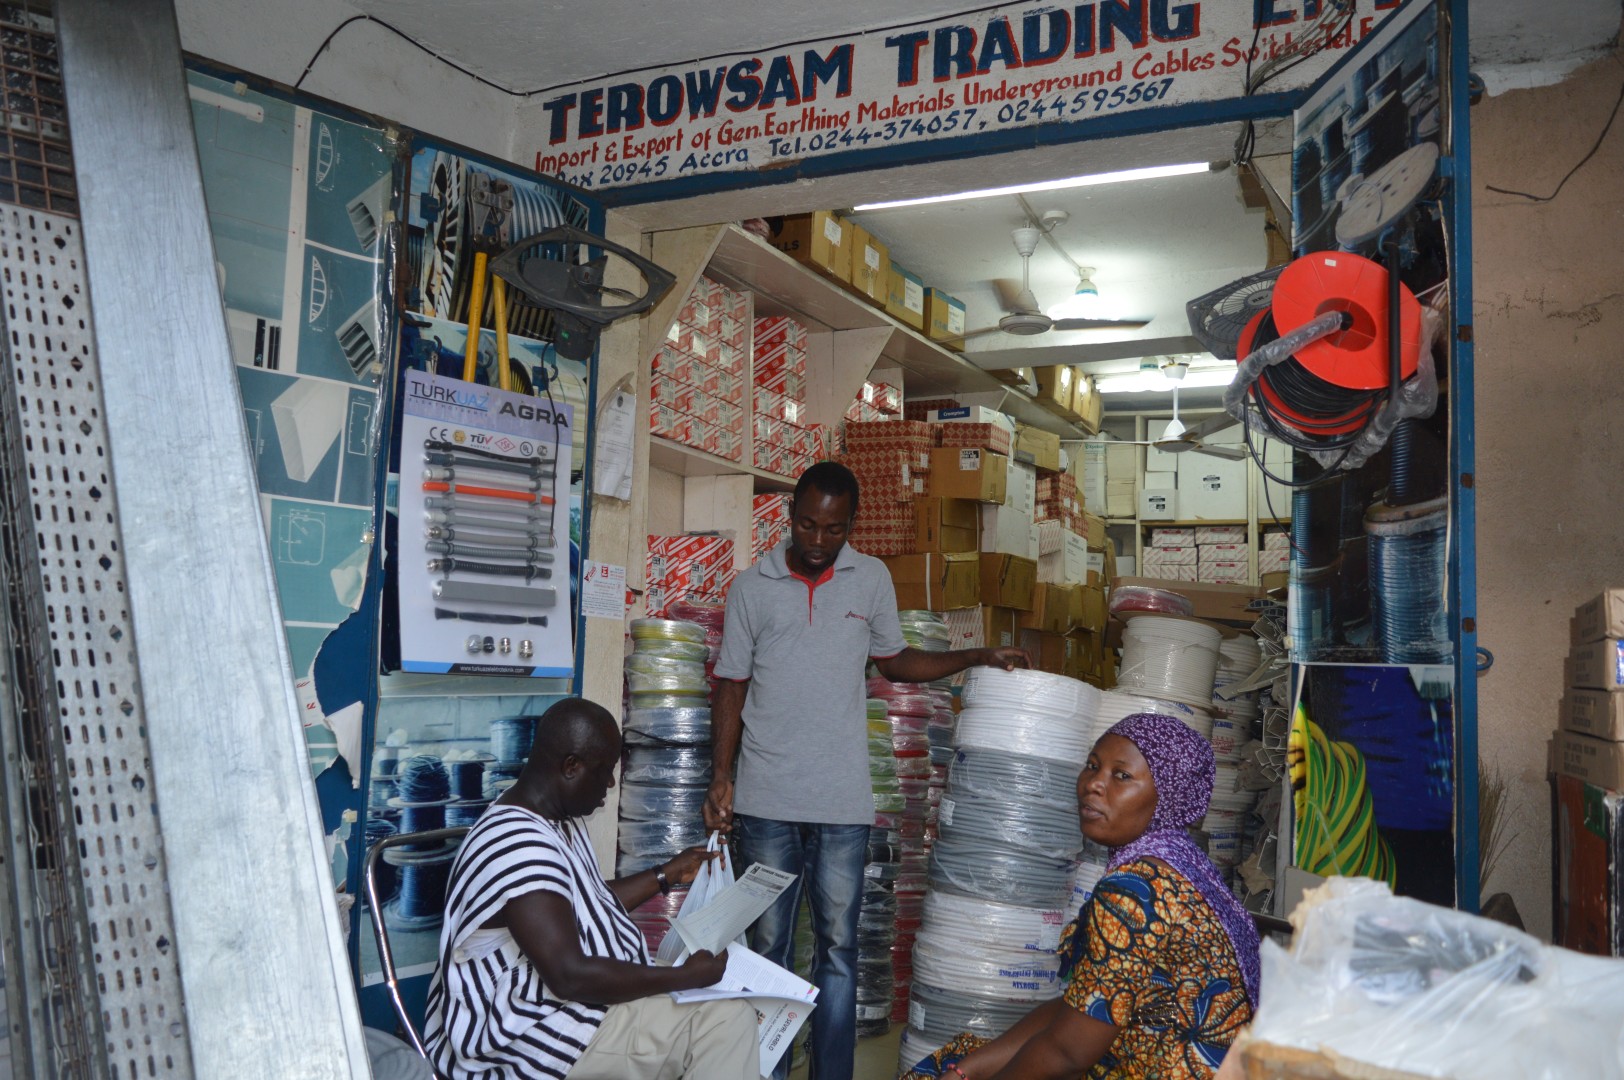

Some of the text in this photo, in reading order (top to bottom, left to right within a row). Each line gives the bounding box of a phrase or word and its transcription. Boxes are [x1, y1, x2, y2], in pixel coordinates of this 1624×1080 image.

[543, 0, 1200, 145] TEROWSAM TRADING
[535, 141, 599, 174] Import
[604, 141, 618, 162] &
[623, 128, 684, 160] Export
[692, 128, 712, 150] of
[857, 87, 955, 124] Materials
[963, 61, 1122, 106] Underground
[1132, 50, 1215, 76] Cables
[600, 155, 670, 184] 20945
[679, 147, 749, 173] Accra
[411, 380, 569, 428] TURKUAZ AGRA
[429, 426, 449, 442] CE
[470, 433, 494, 445] TÜV
